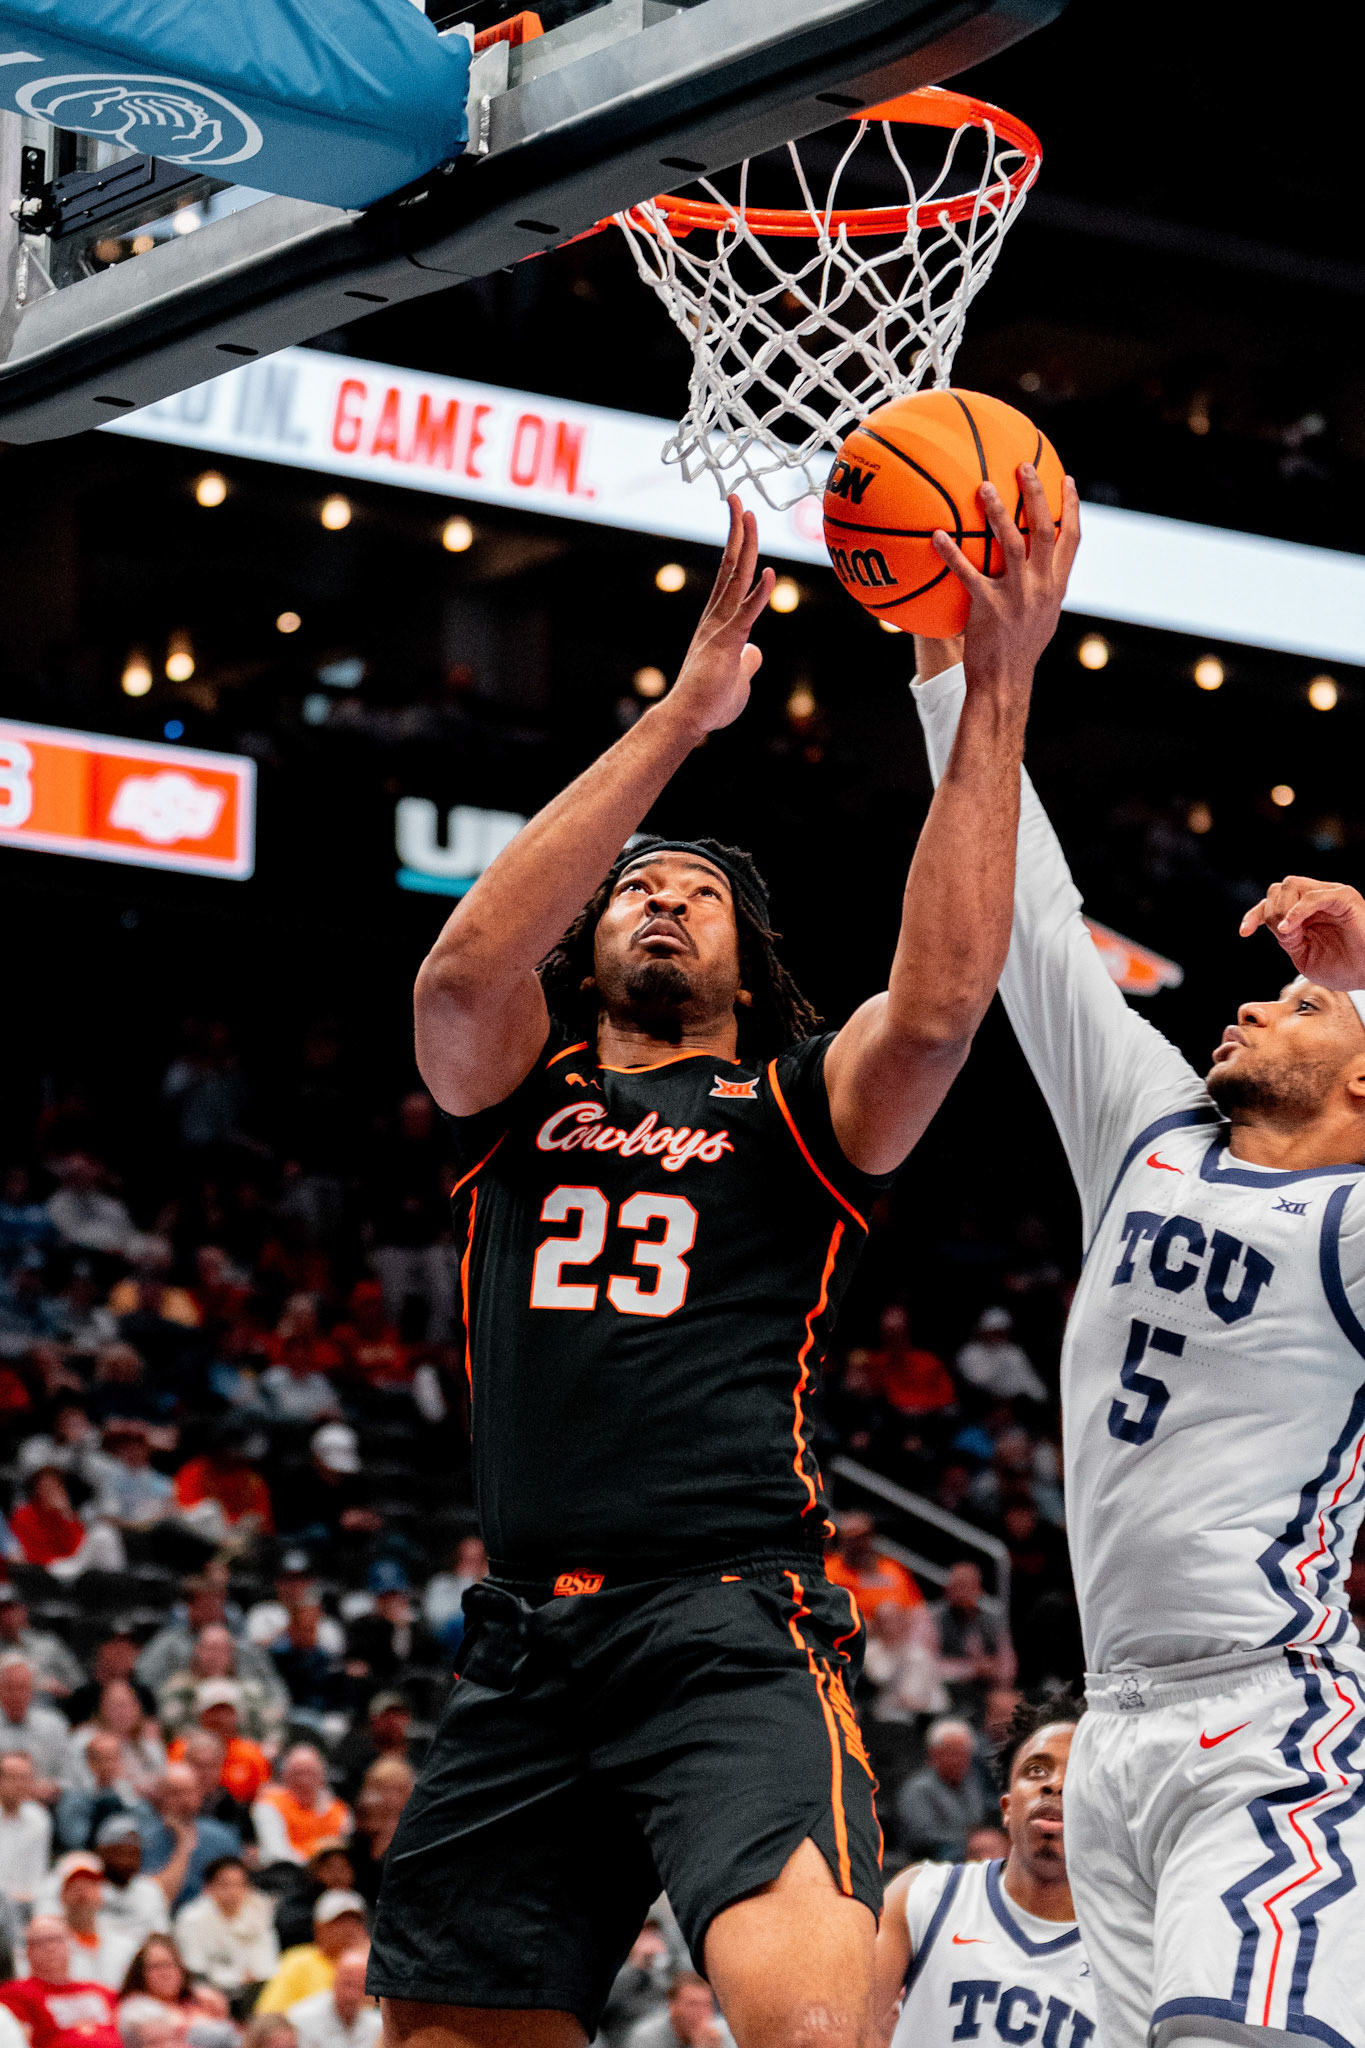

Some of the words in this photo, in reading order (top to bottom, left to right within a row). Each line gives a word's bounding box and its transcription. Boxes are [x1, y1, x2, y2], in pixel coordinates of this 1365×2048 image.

[332, 378, 492, 479] GAME
[509, 413, 596, 499] ON.
[536, 1101, 734, 1172] Cowboys
[529, 1184, 699, 1318] 23
[1111, 1210, 1275, 1325] TCU
[1107, 1318, 1187, 1446] 5
[948, 1979, 1097, 2048] TCU
